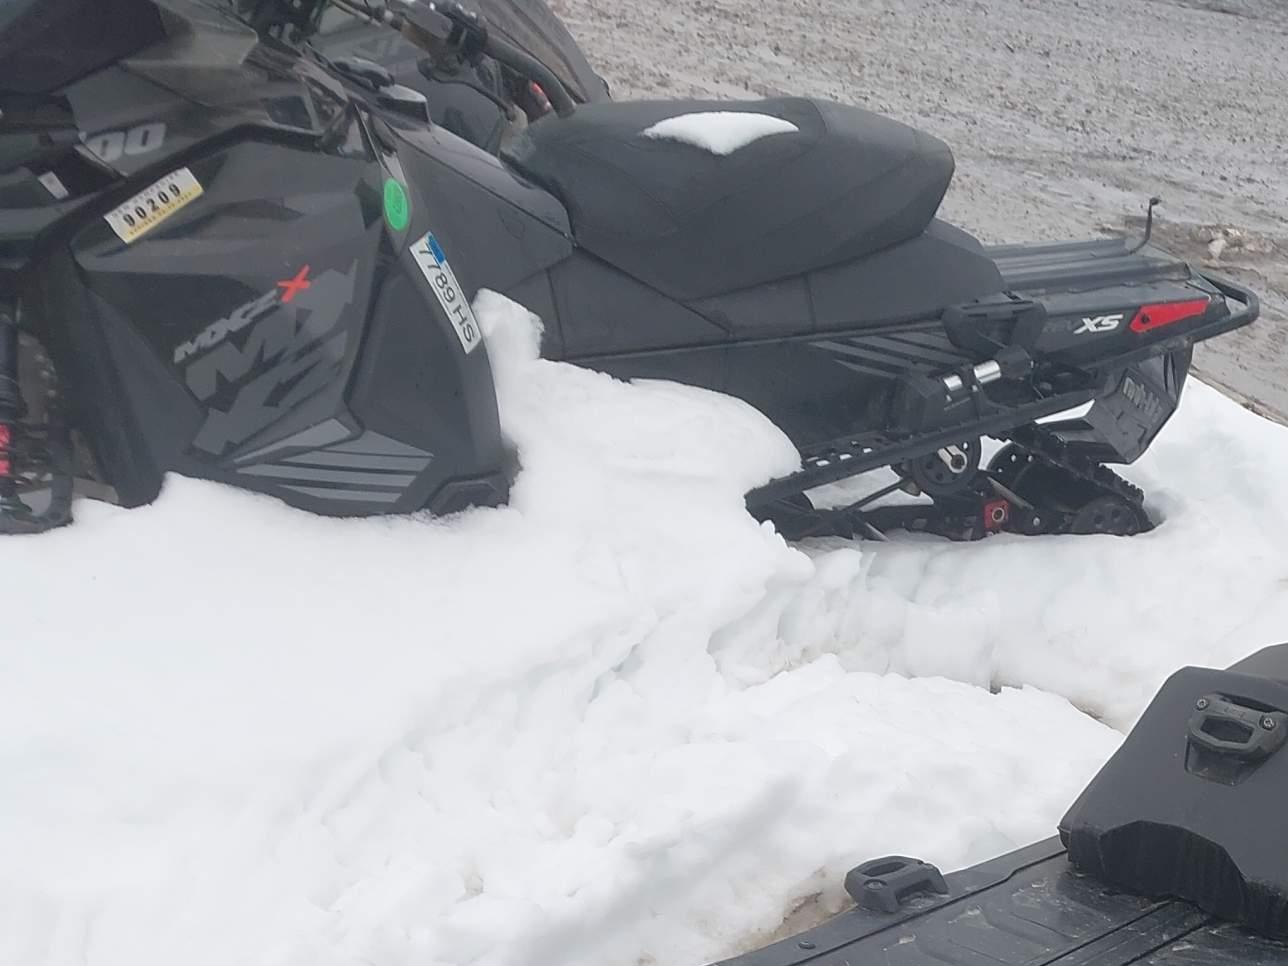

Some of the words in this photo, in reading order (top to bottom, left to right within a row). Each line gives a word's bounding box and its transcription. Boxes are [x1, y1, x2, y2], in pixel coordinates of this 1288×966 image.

[123, 183, 180, 227] 90209
[453, 304, 475, 343] HS
[1073, 314, 1124, 335] XS
